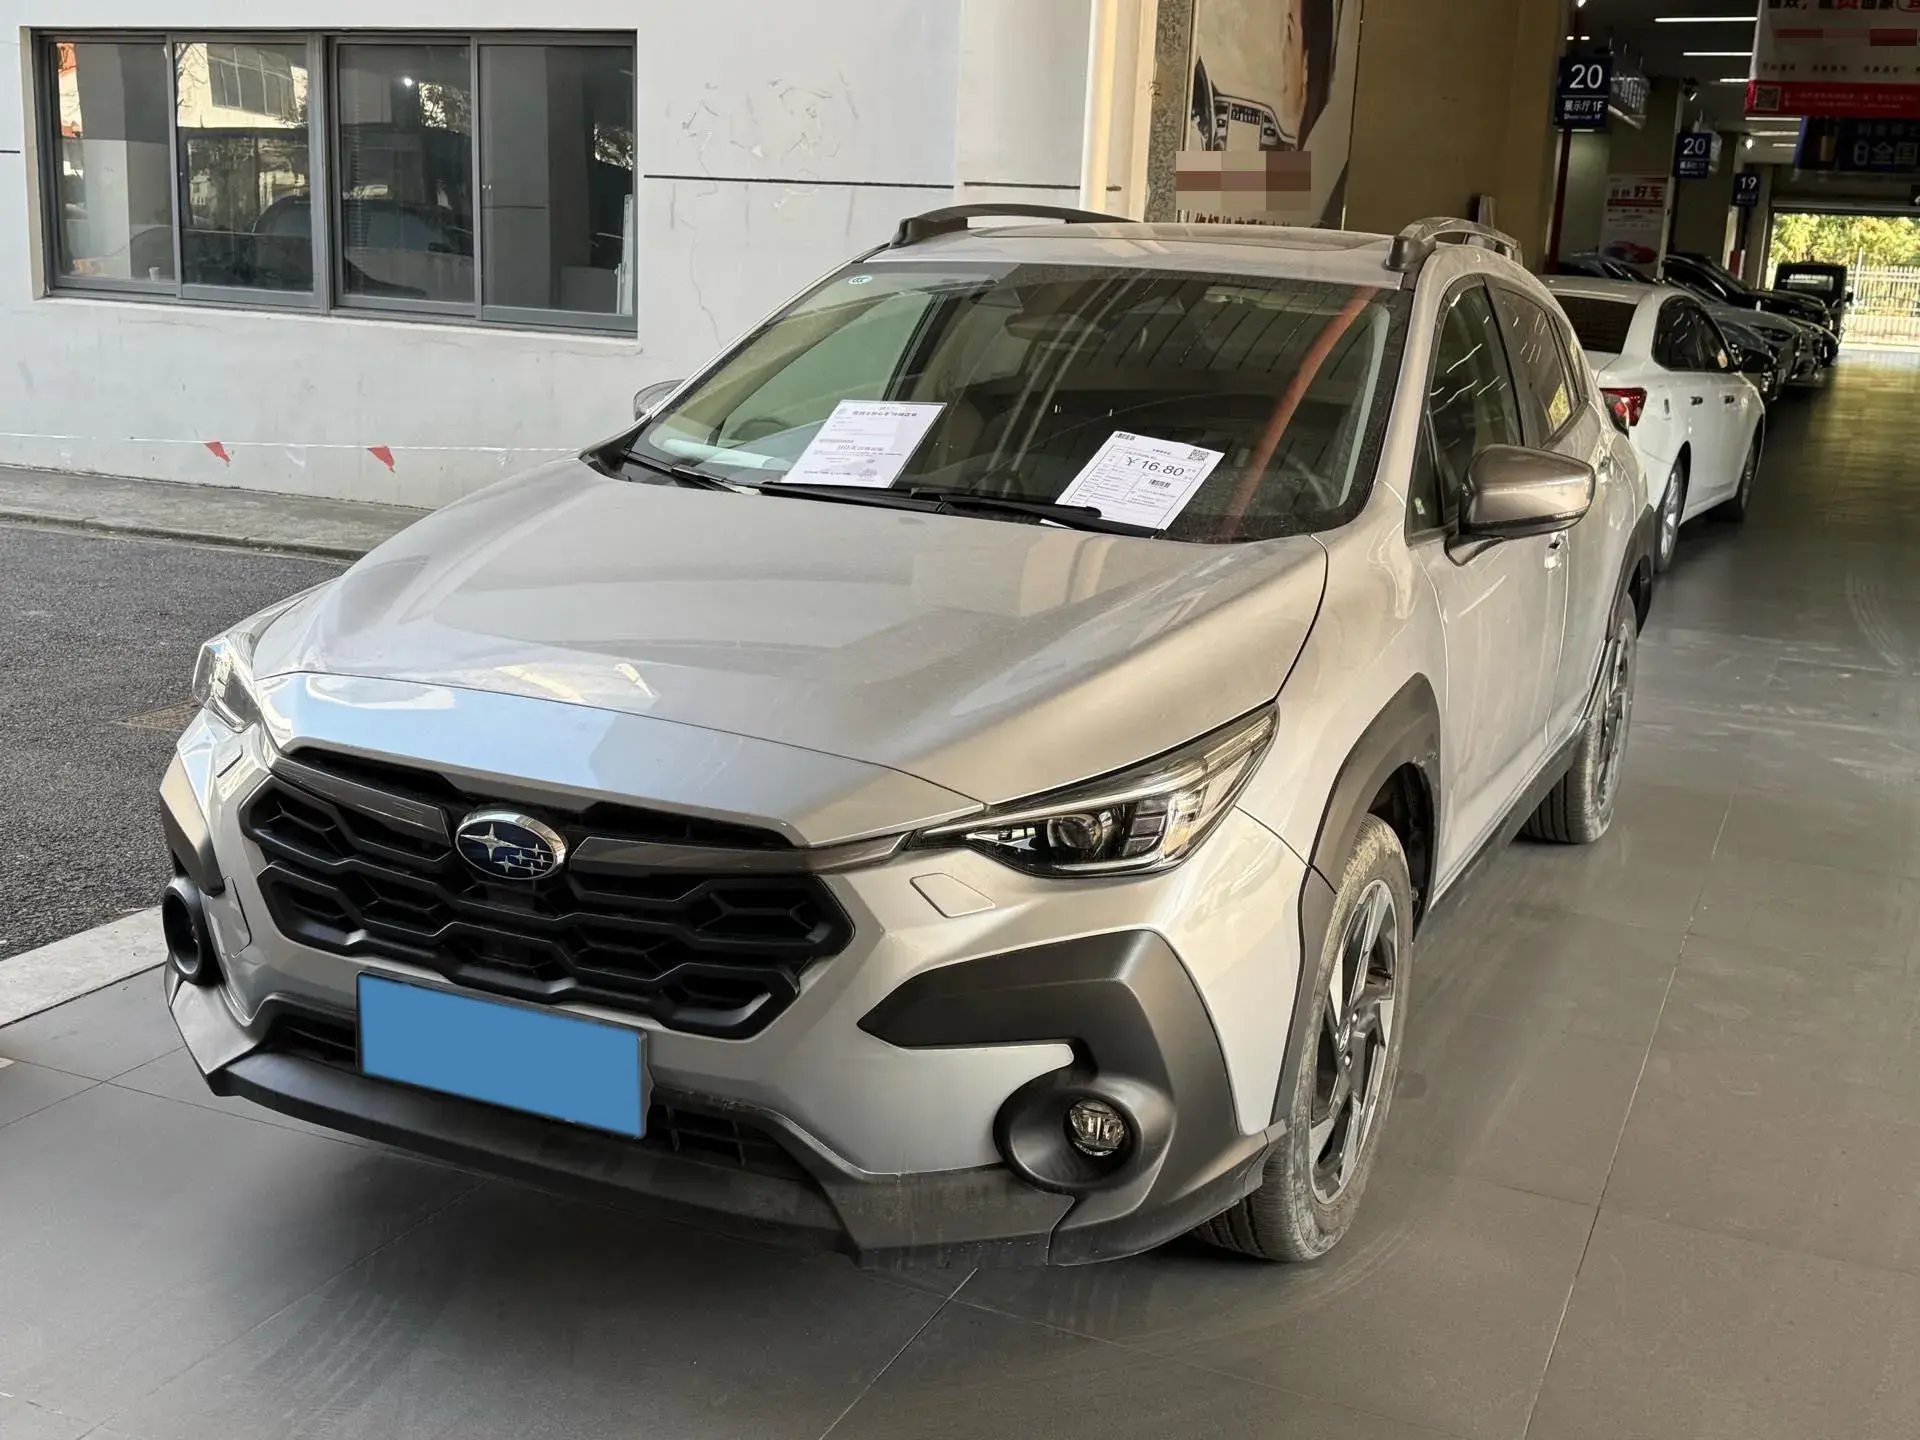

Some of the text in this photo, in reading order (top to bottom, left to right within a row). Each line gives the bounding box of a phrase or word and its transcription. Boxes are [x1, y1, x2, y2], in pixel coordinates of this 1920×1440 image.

[1568, 63, 1603, 89] 20
[1592, 100, 1605, 112] 1F
[1682, 137, 1706, 155] 20
[1740, 175, 1758, 190] 19
